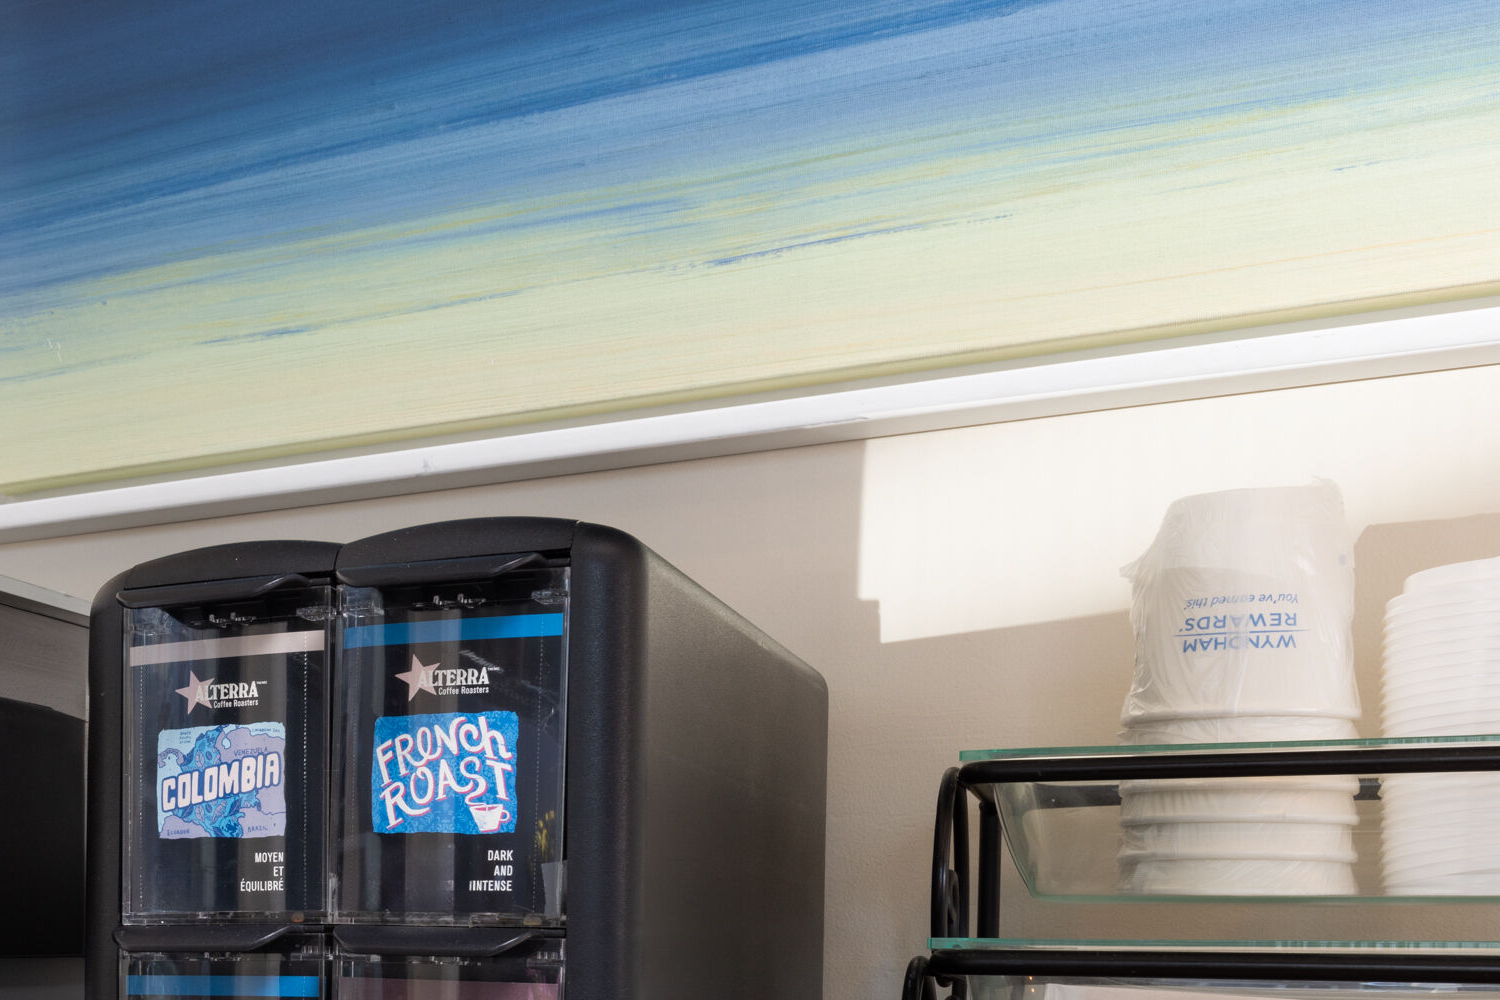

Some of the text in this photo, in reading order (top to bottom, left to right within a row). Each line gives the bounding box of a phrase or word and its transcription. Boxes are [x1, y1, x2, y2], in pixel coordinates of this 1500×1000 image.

[1258, 593, 1299, 604] You've
[1183, 612, 1297, 632] REWARDS
[1183, 635, 1297, 653] WYNDHAM
[418, 666, 490, 687] ALTERRA
[194, 680, 259, 701] ALTERRA
[438, 686, 490, 695] Coffee Roasters
[213, 699, 259, 709] Coffee Roasters
[161, 752, 280, 812] COLOMBIA
[380, 756, 514, 830] ROAST
[254, 852, 284, 863] MOYEN
[487, 849, 514, 861] DARK
[273, 866, 284, 877] ET
[493, 865, 513, 876] AND
[240, 878, 284, 892] ÉQUILIBRÉ
